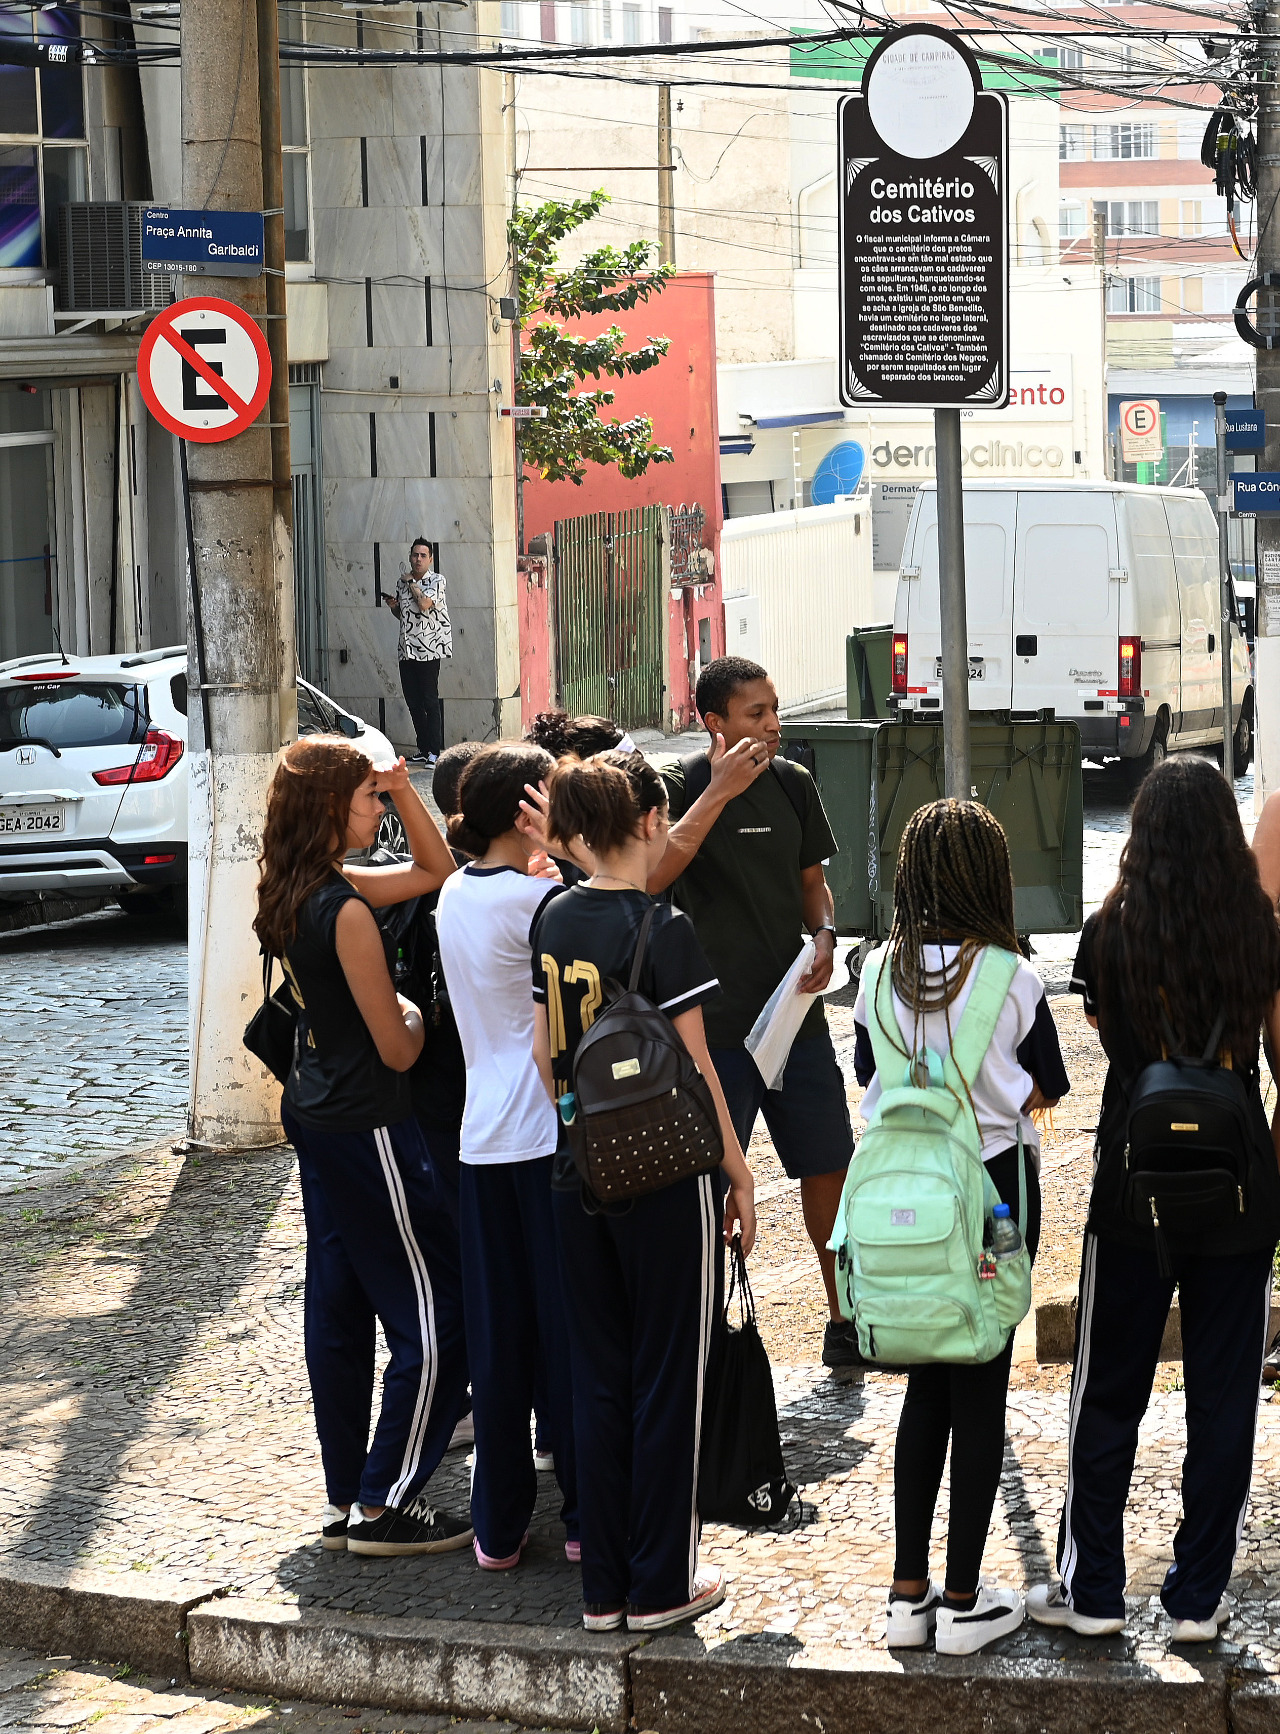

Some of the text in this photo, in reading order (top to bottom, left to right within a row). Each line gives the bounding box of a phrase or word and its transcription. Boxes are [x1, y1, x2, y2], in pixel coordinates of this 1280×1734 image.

[910, 53, 918, 62] DE
[922, 50, 955, 62] CAMPINAS
[870, 177, 975, 199] Cemitério
[870, 205, 975, 223] dos Cativos
[146, 225, 212, 239] Praça Annita
[856, 234, 862, 242] O
[864, 234, 883, 242] fiscal
[885, 234, 921, 244] municipal
[961, 234, 990, 242] Câmara
[208, 243, 259, 256] Garibaldi
[873, 245, 887, 254] que
[896, 244, 930, 252] cemitério
[932, 244, 946, 252] dos
[948, 244, 972, 254] pretos
[854, 254, 906, 262] encontrava-se
[921, 254, 933, 262] tão
[935, 254, 948, 262] mal
[950, 254, 976, 262] estado
[978, 255, 992, 264] que
[164, 264, 197, 272] 13015-180
[872, 263, 888, 272] cães
[862, 274, 984, 284] das sepulturas, banqueteando-se
[877, 283, 894, 292] eles.
[896, 283, 908, 292] Em
[950, 283, 971, 294] longo
[973, 283, 987, 292] dos
[867, 295, 886, 304] anos,
[888, 293, 913, 302] existiu
[929, 293, 950, 304] ponto
[966, 295, 980, 304] que
[873, 303, 890, 312] acha
[921, 303, 930, 312] de
[932, 303, 947, 312] São
[949, 303, 984, 313] Benedito,
[859, 313, 878, 322] havia
[894, 313, 928, 322] cemitério
[942, 313, 961, 323] largo
[963, 313, 988, 323] lateral,
[870, 323, 905, 332] destinado
[963, 323, 977, 332] dos
[863, 332, 910, 341] escravizados
[913, 334, 926, 343] que
[939, 332, 984, 341] denominava
[901, 342, 915, 351] dos
[956, 342, 987, 351] Também
[859, 352, 988, 362] chamado de Cemitério dos Negros,
[180, 328, 228, 410] E
[867, 364, 879, 373] por
[906, 362, 946, 373] sepultados
[962, 362, 981, 373] lugar
[881, 372, 965, 383] separado dos brancos.
[1135, 410, 1146, 429] E
[1236, 422, 1257, 432] Lusitana
[1238, 482, 1256, 492] Rua
